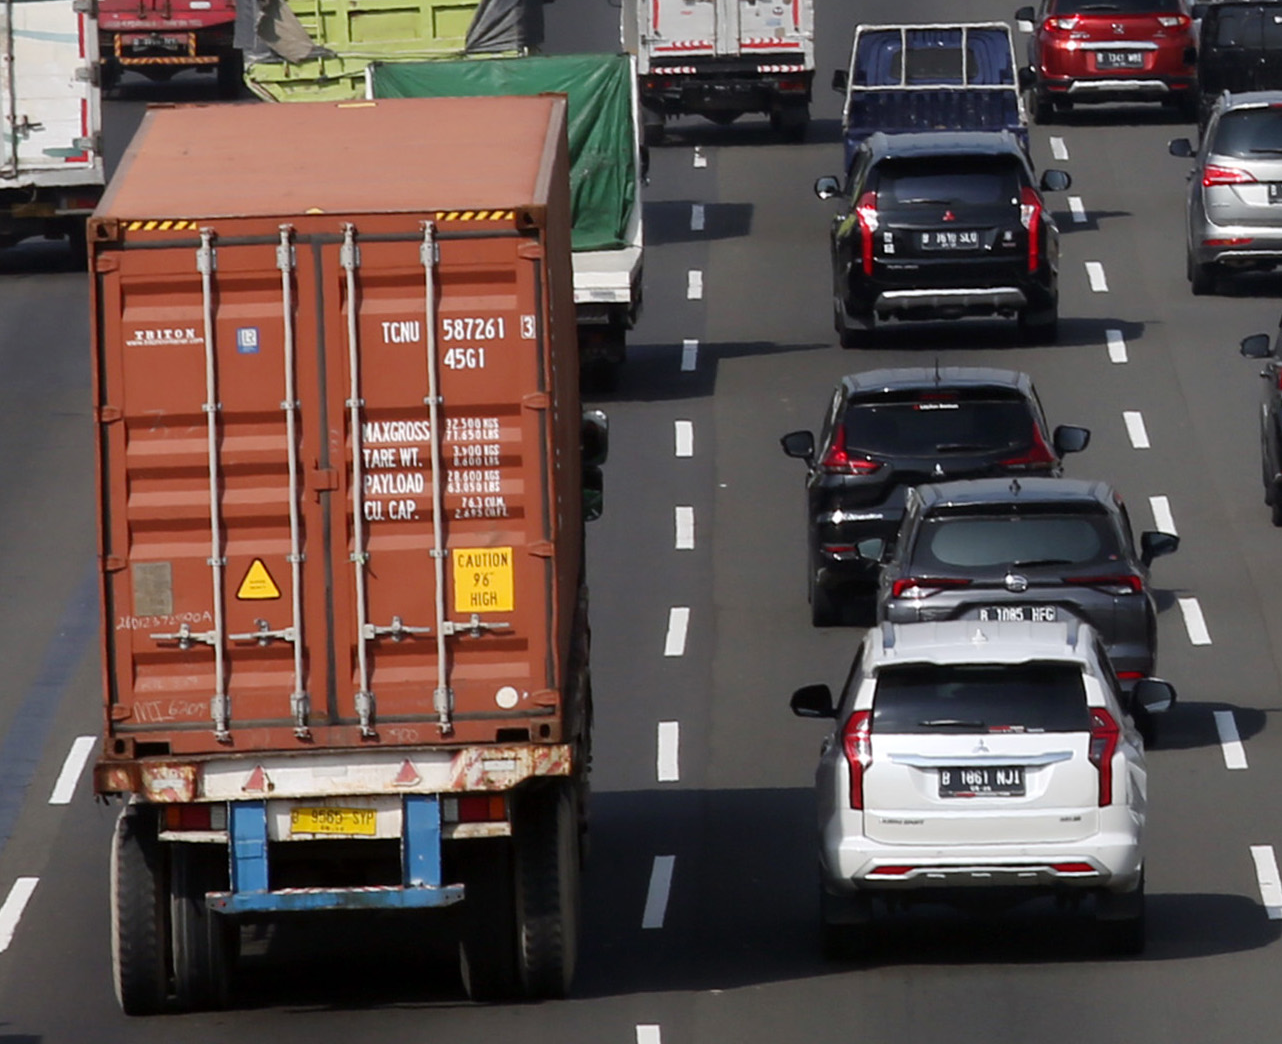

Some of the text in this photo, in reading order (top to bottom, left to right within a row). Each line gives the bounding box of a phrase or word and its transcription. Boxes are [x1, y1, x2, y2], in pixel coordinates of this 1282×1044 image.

[134, 328, 195, 340] TRITON
[382, 316, 534, 344] TCNU 587261 3
[443, 348, 485, 370] 45G1
[363, 421, 430, 442] MAXGROSS
[363, 447, 423, 469] TARE WT.
[364, 473, 424, 494] PAYLOAD
[364, 500, 419, 521] CU. CAP.
[458, 553, 508, 569] CAUTION
[471, 592, 498, 607] HIGH
[942, 772, 951, 785] B
[291, 810, 300, 824] B
[352, 811, 375, 826] SYP
